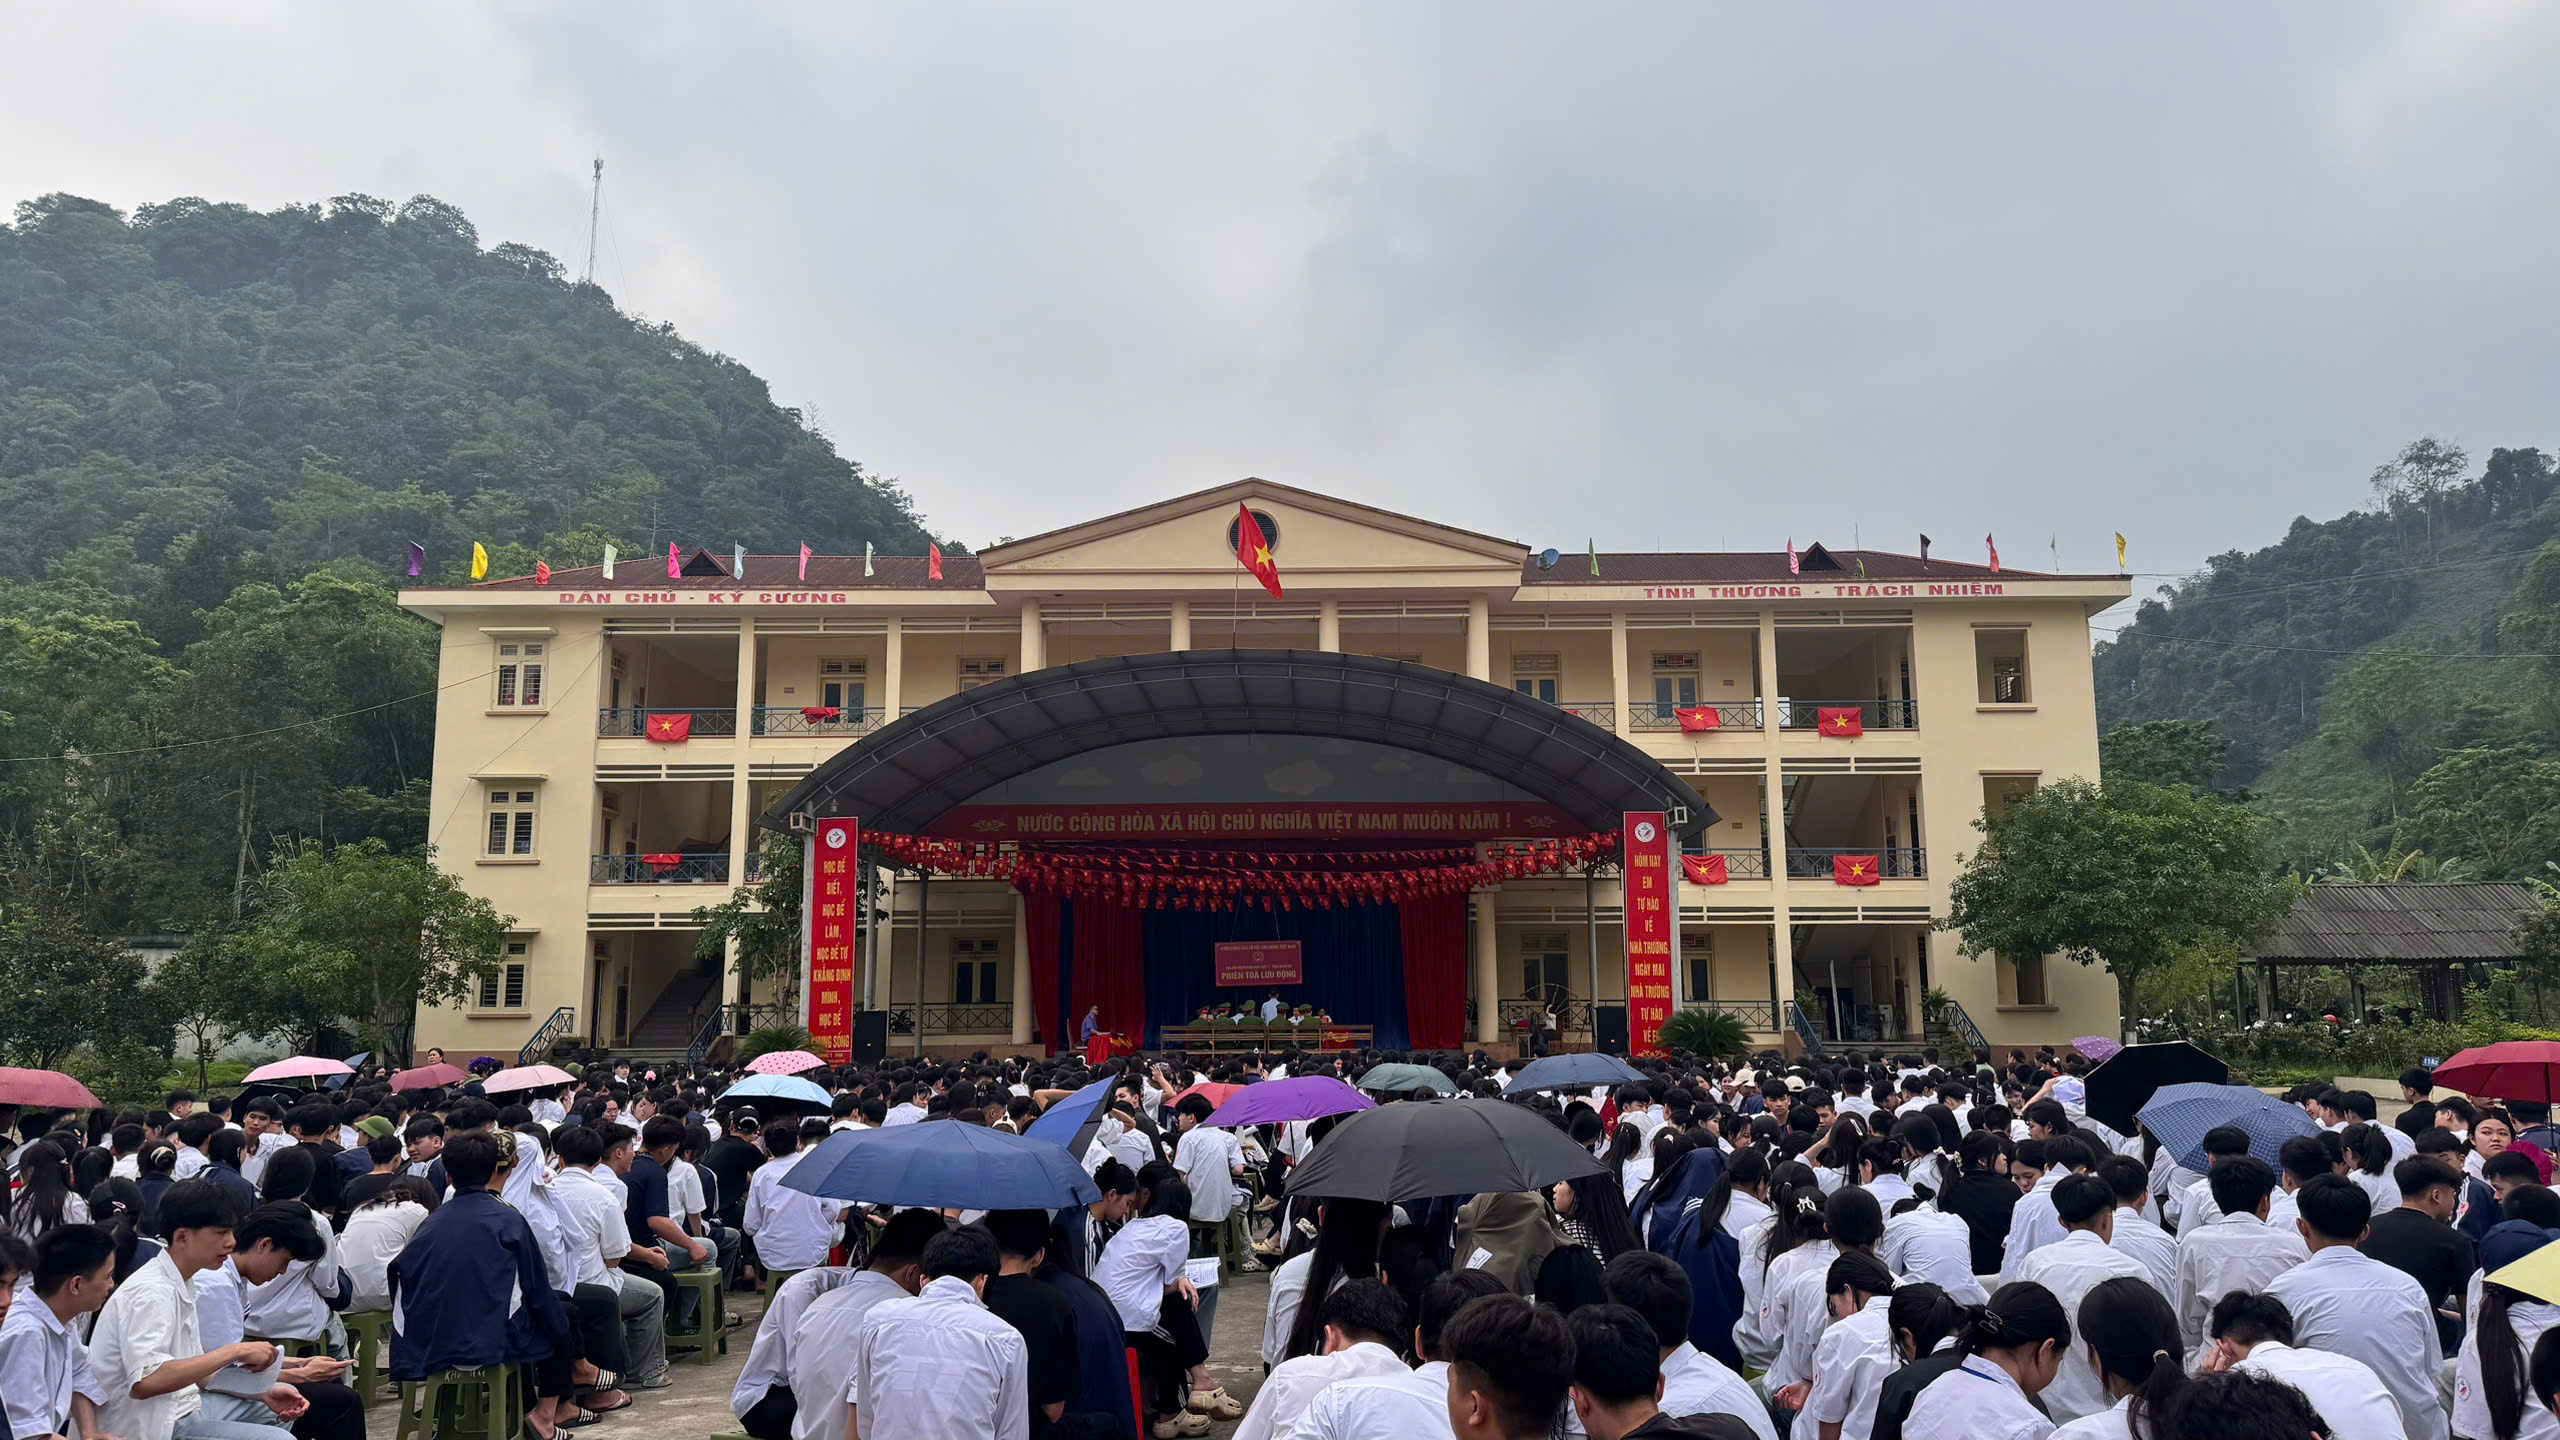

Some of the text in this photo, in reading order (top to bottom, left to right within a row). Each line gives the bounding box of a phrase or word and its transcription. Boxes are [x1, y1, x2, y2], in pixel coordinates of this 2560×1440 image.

[559, 590, 611, 604] DÂN
[625, 588, 676, 604] CHỦ
[759, 592, 847, 604] CƯƠNG
[1643, 585, 1695, 599] TÌNH
[1709, 585, 1801, 599] THƯƠNG
[1833, 583, 1915, 597] TRÁCH
[1928, 582, 2003, 597] NHIỆM
[1016, 811, 1064, 833] NƯỚC
[1069, 811, 1116, 835] CỘNG
[1120, 810, 1155, 832] HÒA
[1160, 811, 1183, 832] XÃ
[1188, 810, 1216, 834] HỘI
[1221, 808, 1255, 831] CHỦ
[1260, 810, 1313, 830] NGHĨA
[1318, 809, 1353, 833] VIỆT
[1358, 812, 1398, 830] NAM
[1402, 810, 1455, 830] MUÔN
[1459, 810, 1500, 830] NĂM
[1649, 855, 1662, 868] NAY
[1642, 876, 1653, 889] EM
[1652, 963, 1665, 977] MAI
